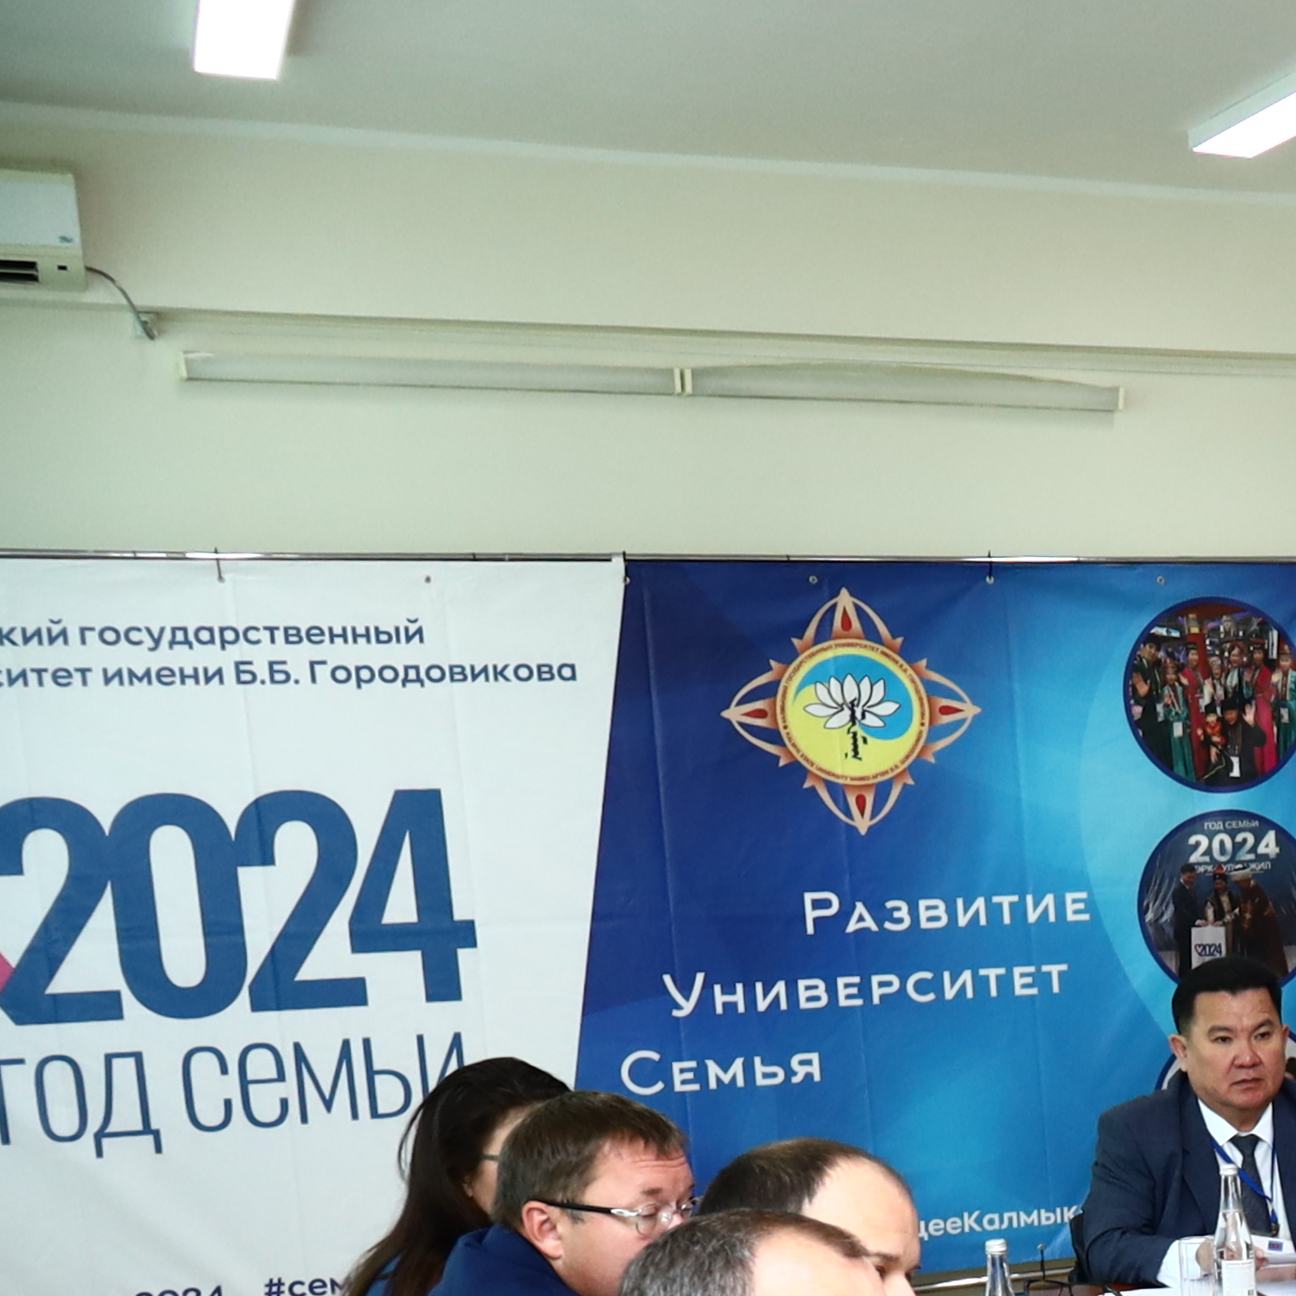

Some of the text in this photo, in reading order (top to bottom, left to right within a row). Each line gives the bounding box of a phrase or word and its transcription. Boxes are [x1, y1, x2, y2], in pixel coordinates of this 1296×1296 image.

[79, 617, 424, 650] государственный
[0, 659, 578, 689] итет имени Б.Б. Городовикова
[1188, 829, 1280, 864] 2024
[0, 788, 478, 1026] 2024
